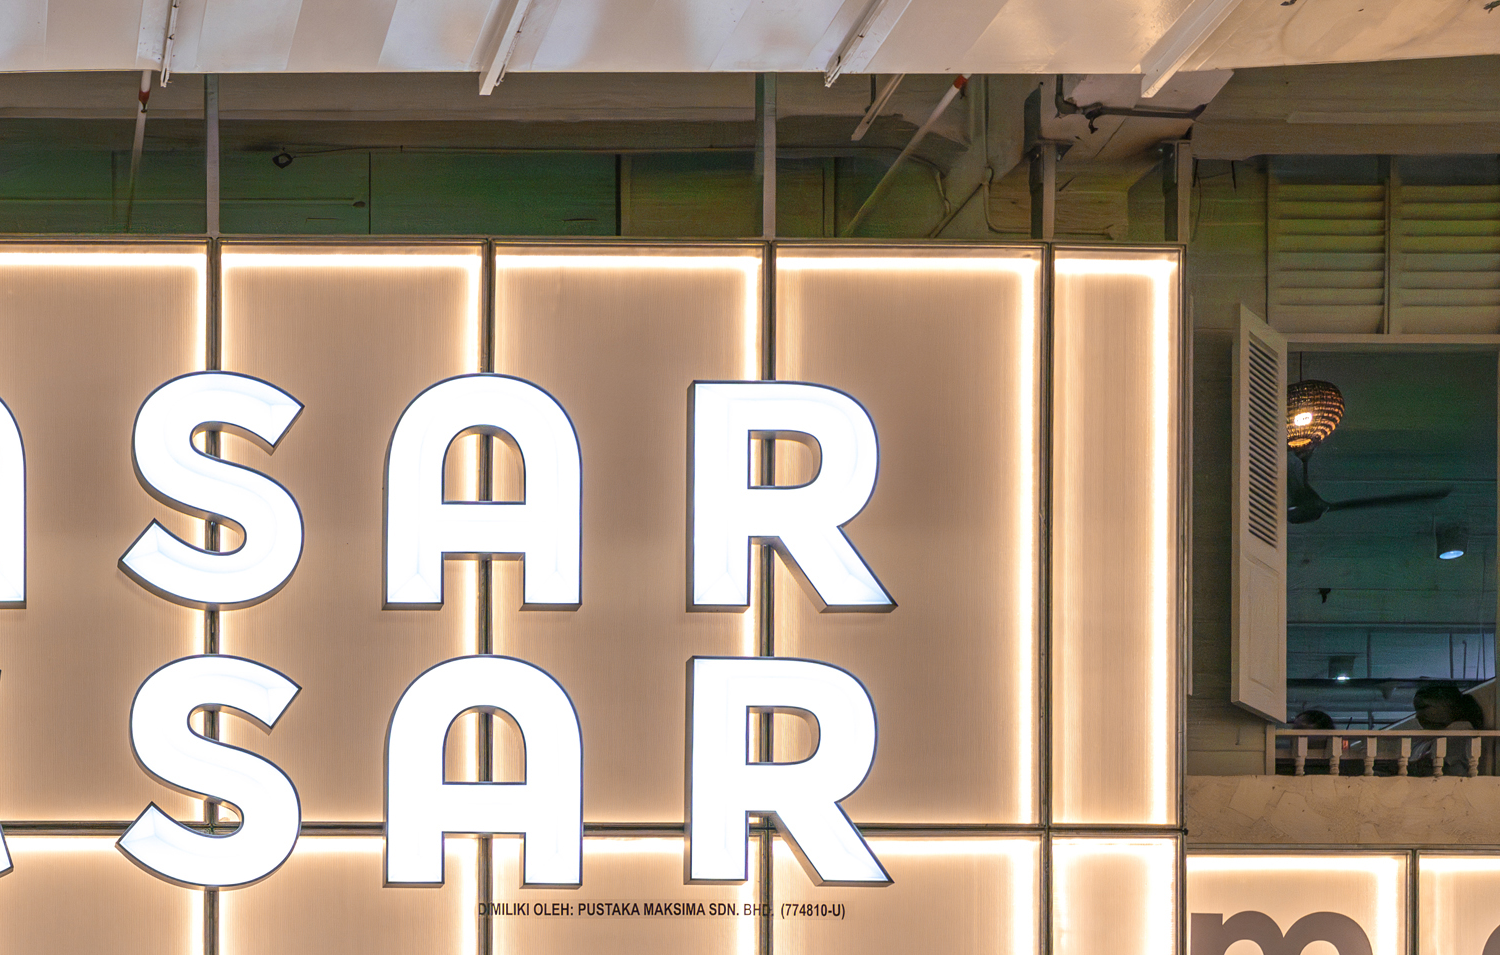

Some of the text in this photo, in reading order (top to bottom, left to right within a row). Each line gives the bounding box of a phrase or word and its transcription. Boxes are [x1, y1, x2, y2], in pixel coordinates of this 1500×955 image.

[478, 902, 846, 920] DIMILIKI OLEH: PUSTAKA MAKSIMA SDN. BHD. (774810-U)
